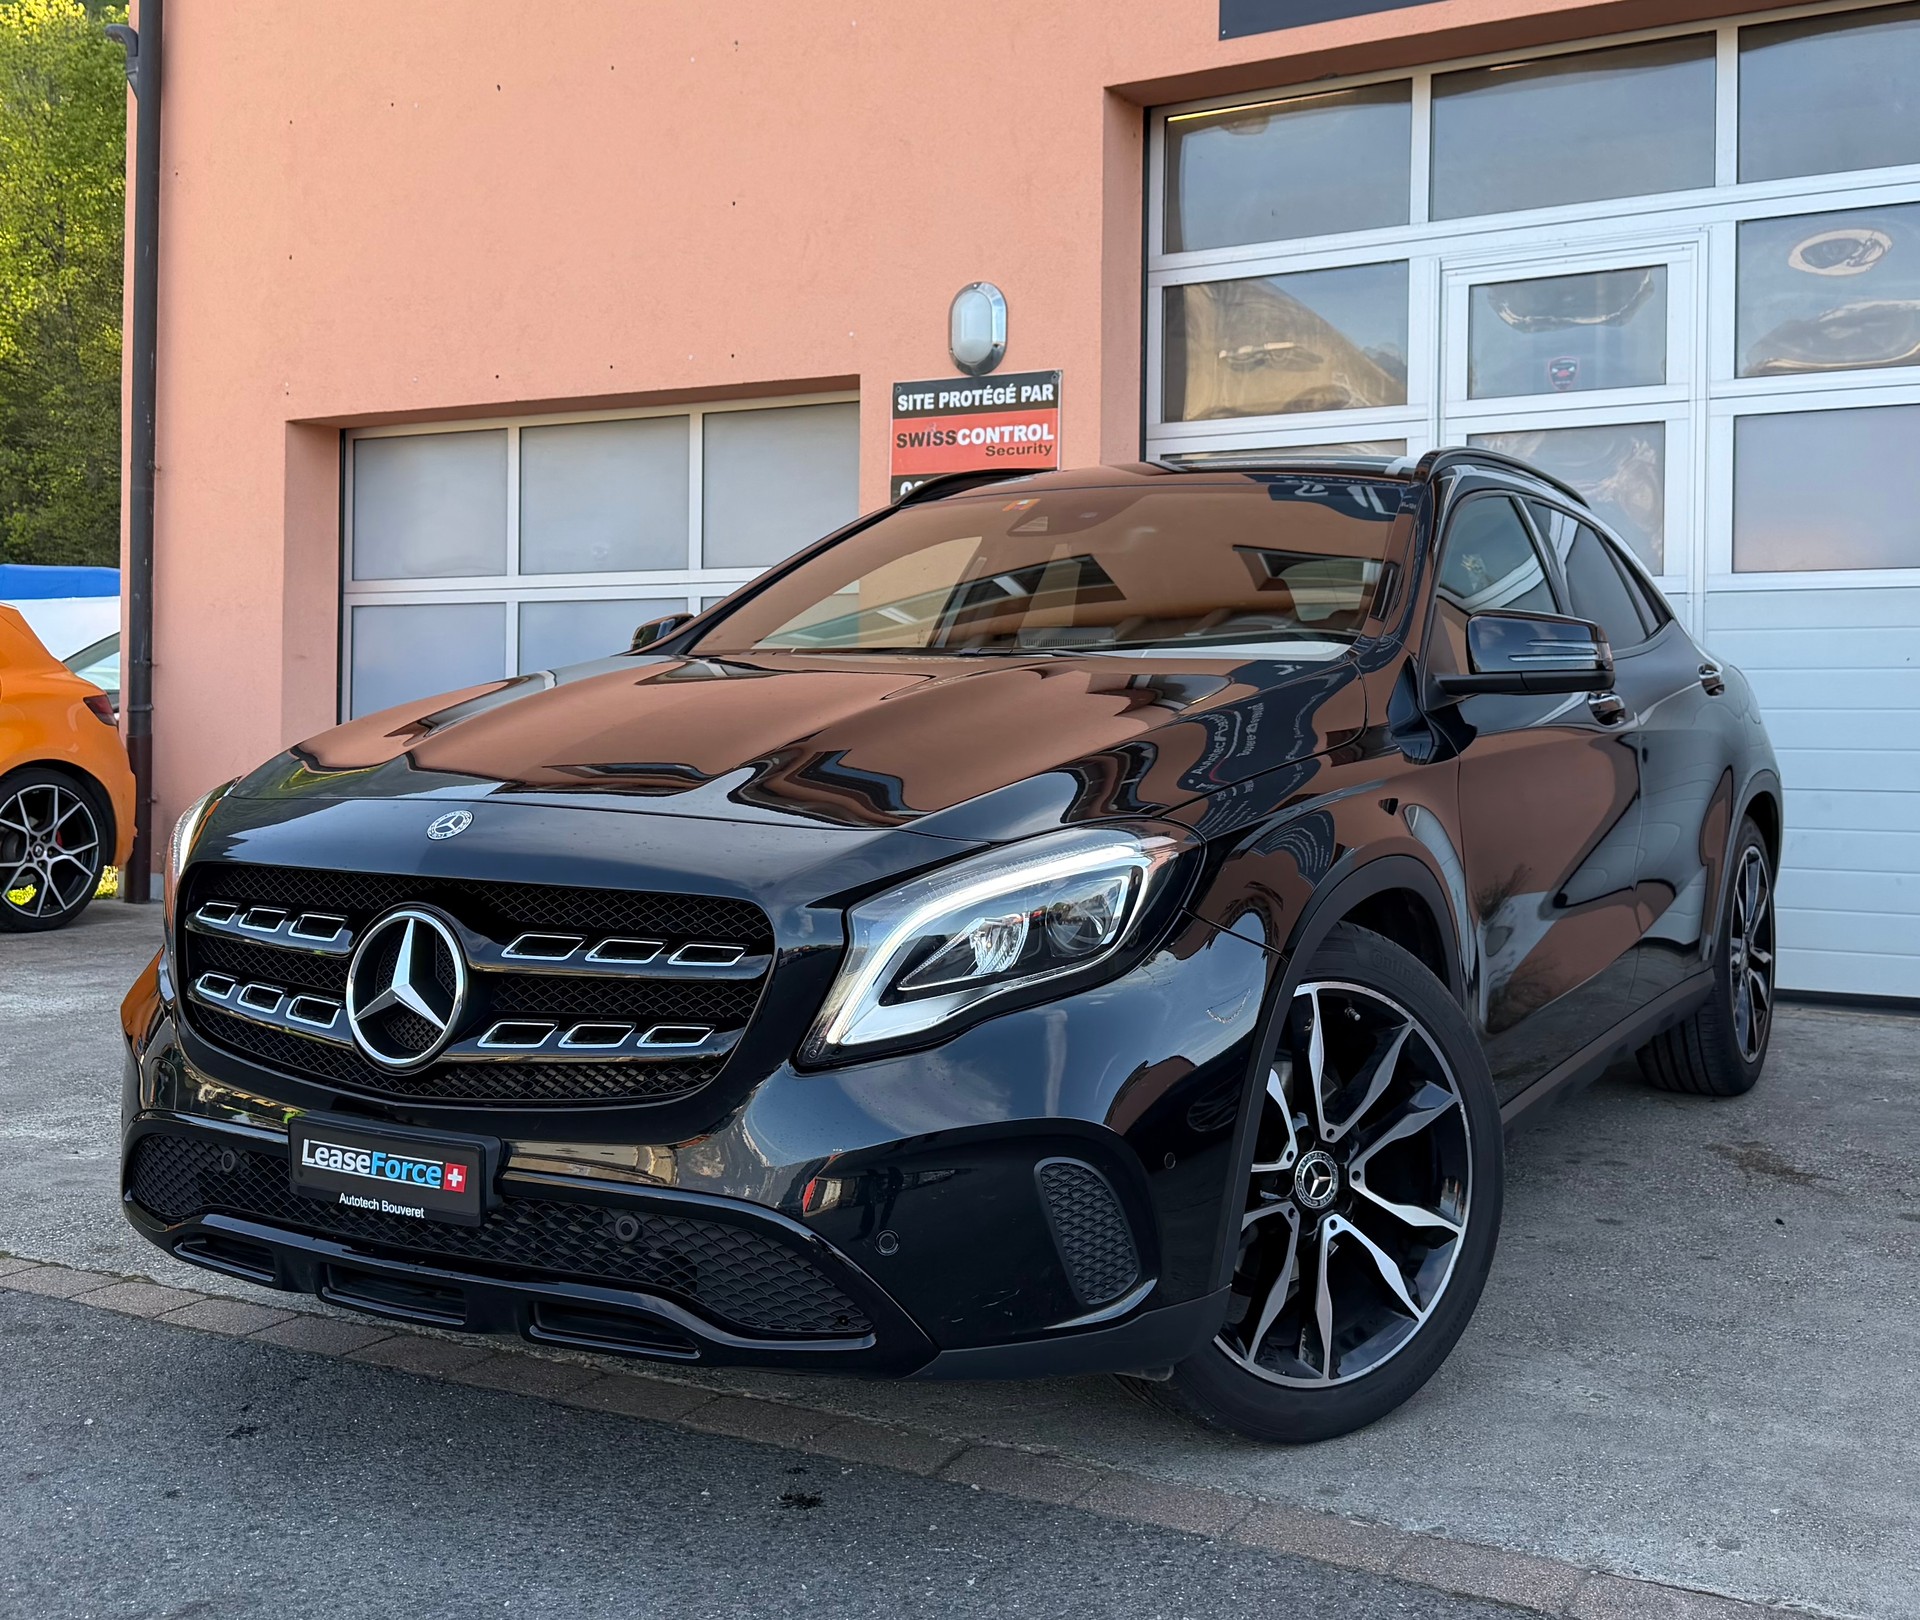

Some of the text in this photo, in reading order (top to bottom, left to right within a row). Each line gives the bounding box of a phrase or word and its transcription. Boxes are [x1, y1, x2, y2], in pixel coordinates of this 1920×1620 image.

[897, 383, 1054, 411] SITE PROTÉGÉ PAR
[985, 442, 1053, 457] Security
[900, 480, 925, 496] 0
[302, 1138, 443, 1186] LeaseForce
[339, 1192, 425, 1219] Autotech Bouveret
